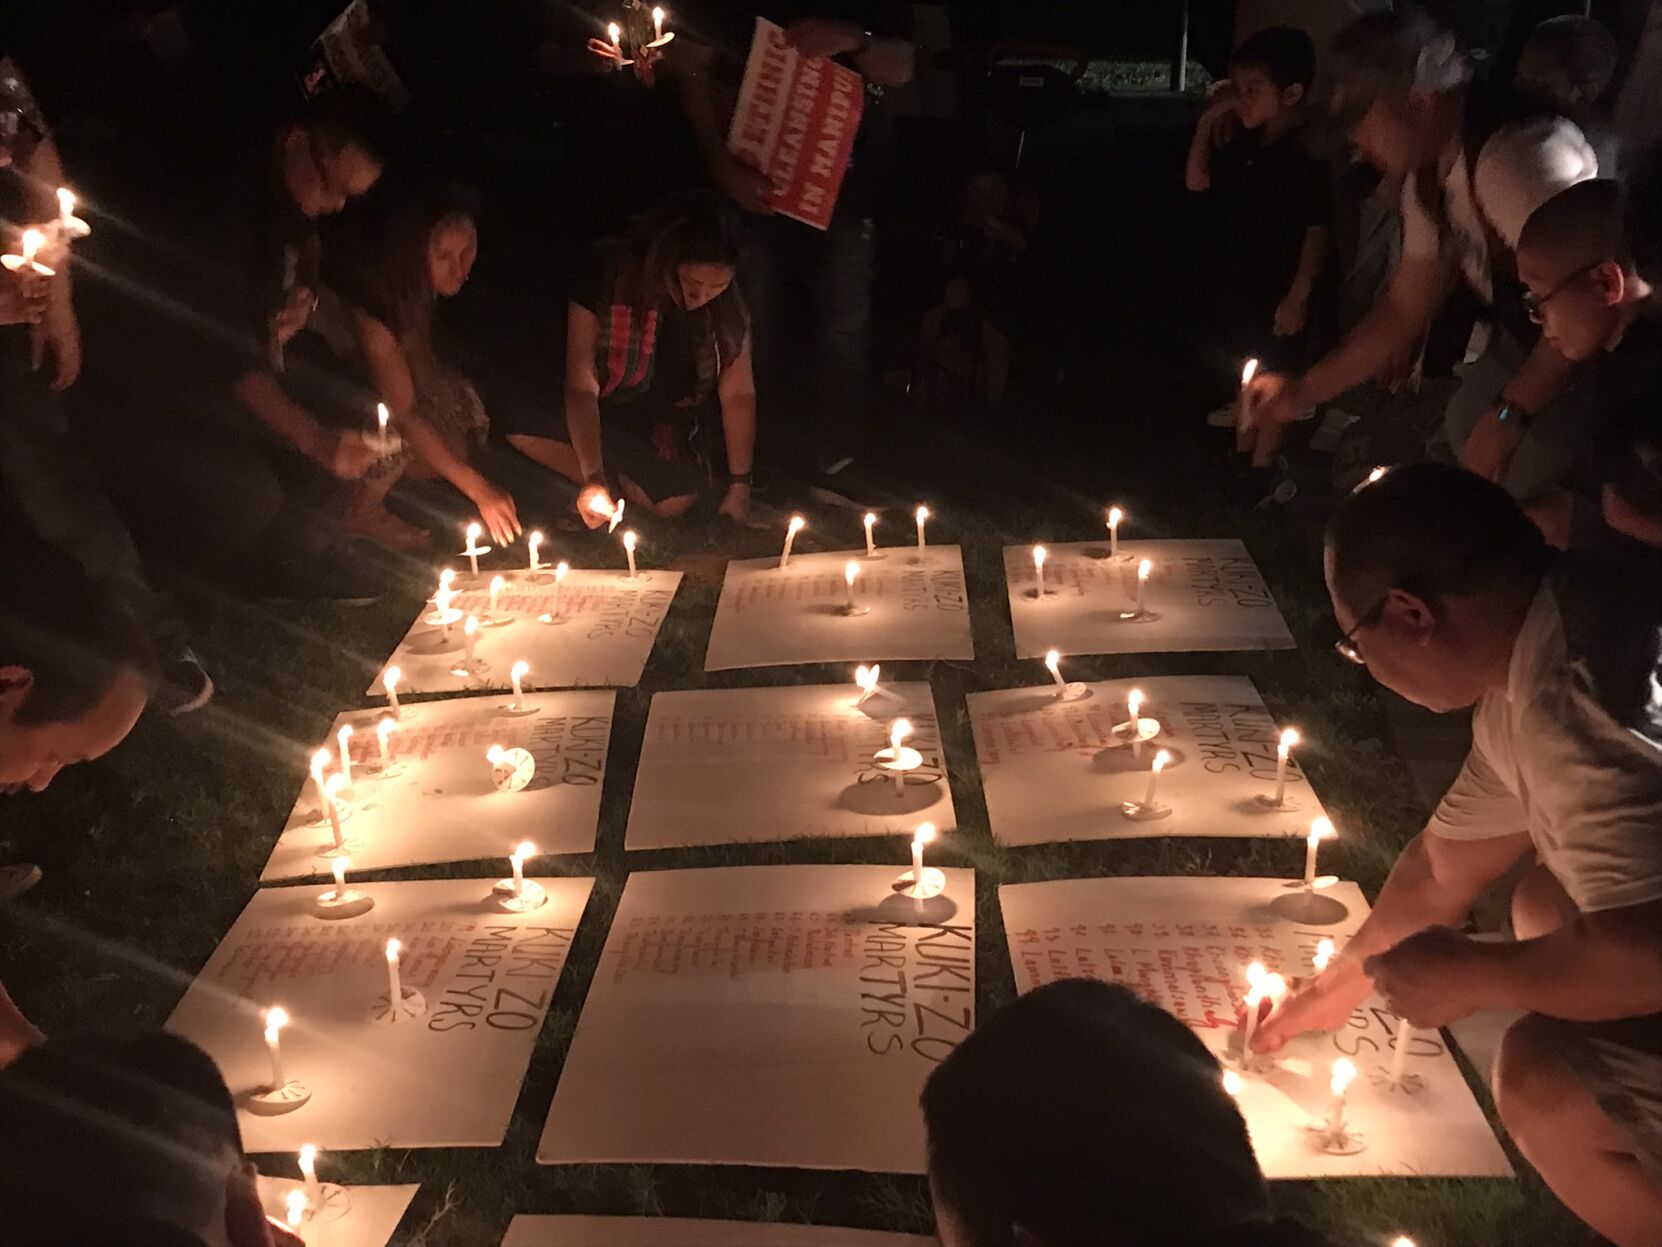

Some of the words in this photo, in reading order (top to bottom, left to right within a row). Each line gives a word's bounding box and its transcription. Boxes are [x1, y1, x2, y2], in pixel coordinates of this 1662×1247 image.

[743, 29, 788, 146] ETHNIC
[810, 65, 856, 178] MANIPU
[797, 181, 827, 216] IN
[1179, 702, 1240, 774] MARTYRS
[428, 926, 518, 1032] MARTYRS
[859, 920, 907, 1056] MARTYRS
